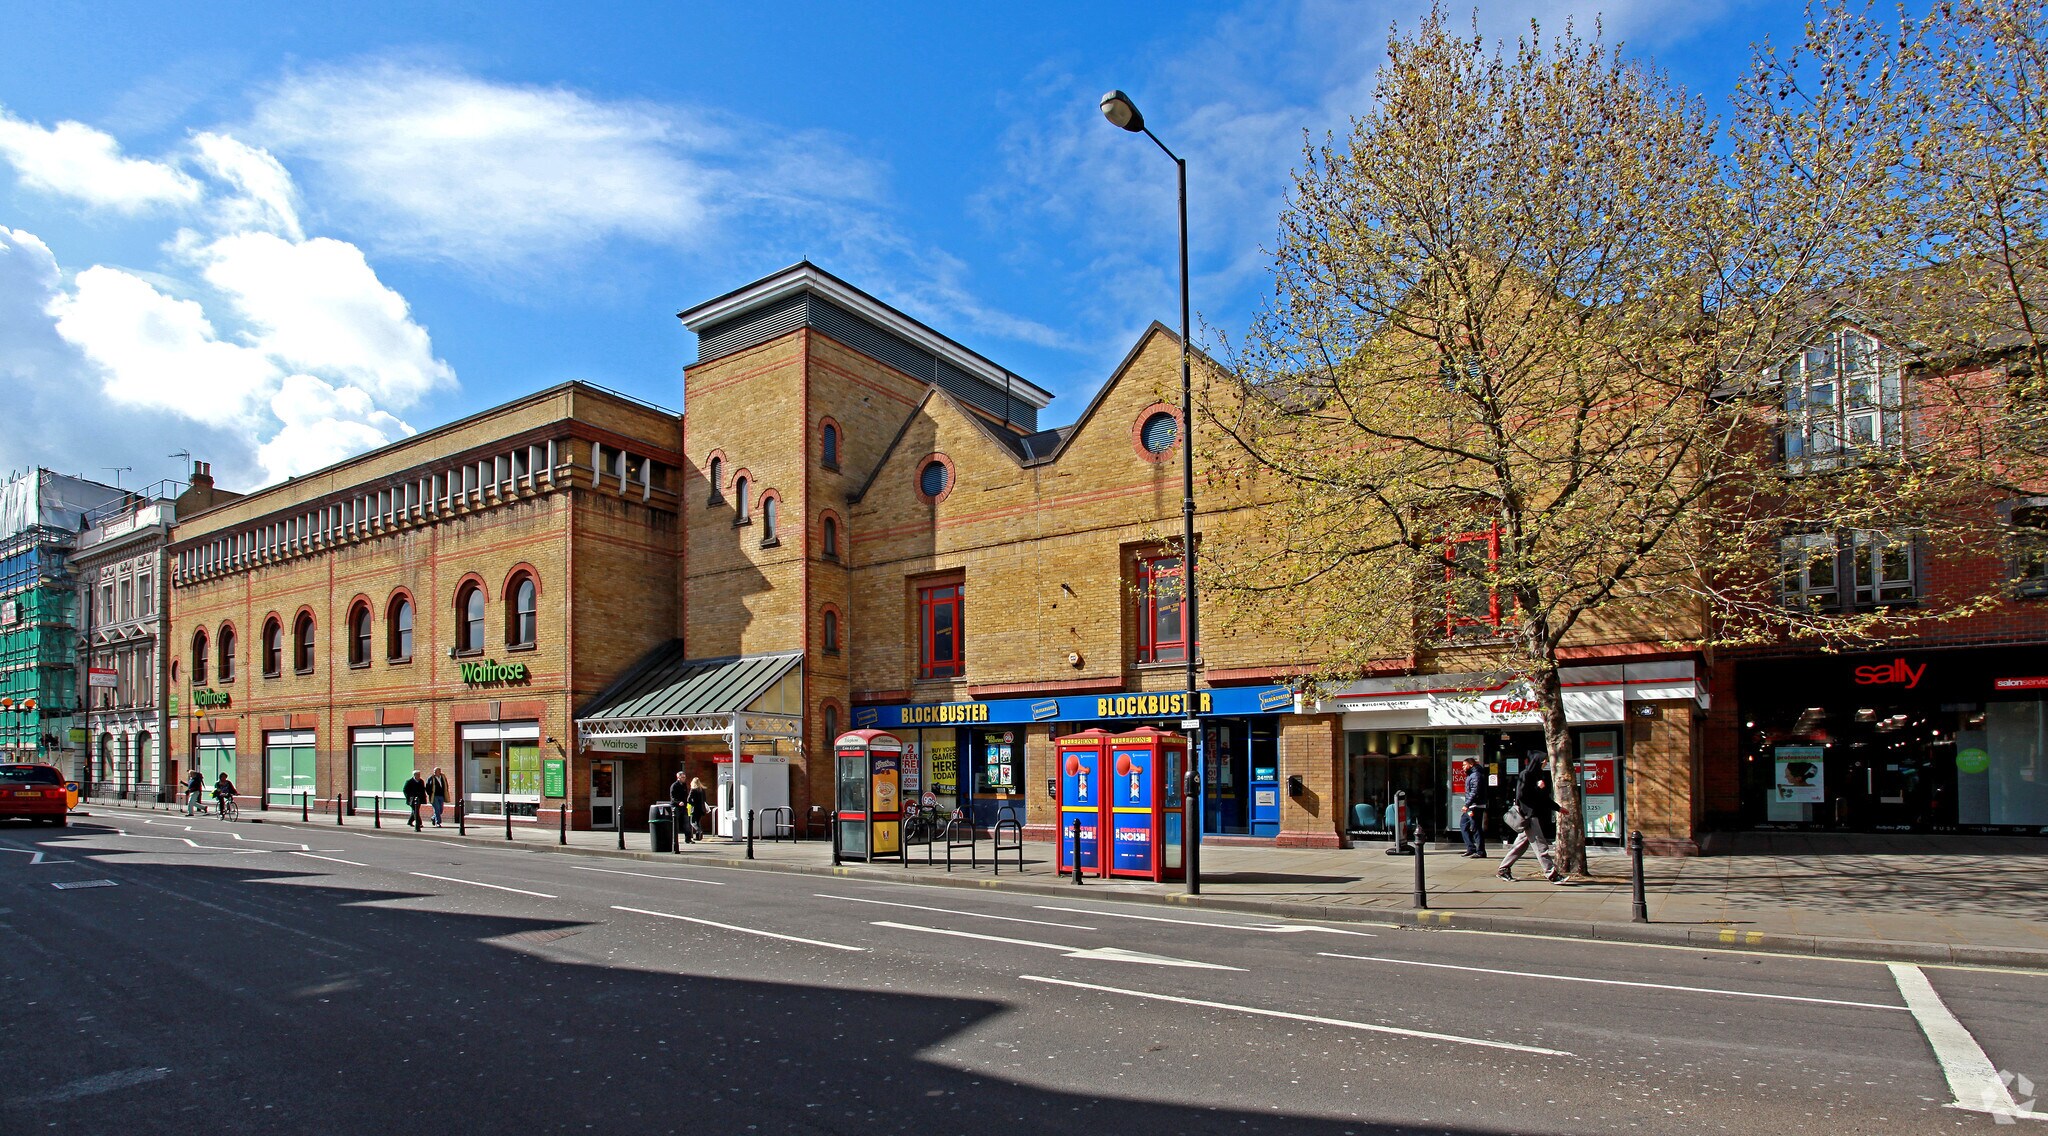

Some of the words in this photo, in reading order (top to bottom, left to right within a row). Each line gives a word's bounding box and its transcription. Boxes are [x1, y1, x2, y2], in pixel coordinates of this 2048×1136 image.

[460, 660, 523, 682] Waitrose
[1855, 658, 1927, 688] sally
[1997, 678, 2048, 687] salonservic
[193, 689, 226, 705] Waitrose
[1098, 693, 1211, 716] BLOCKBUSTR
[1490, 698, 1539, 713] Chels
[901, 704, 988, 724] BLOCKBUSTER
[602, 739, 638, 749] Waitrose
[907, 744, 914, 753] 2
[932, 761, 956, 772] HERE
[933, 772, 956, 780] TODAY
